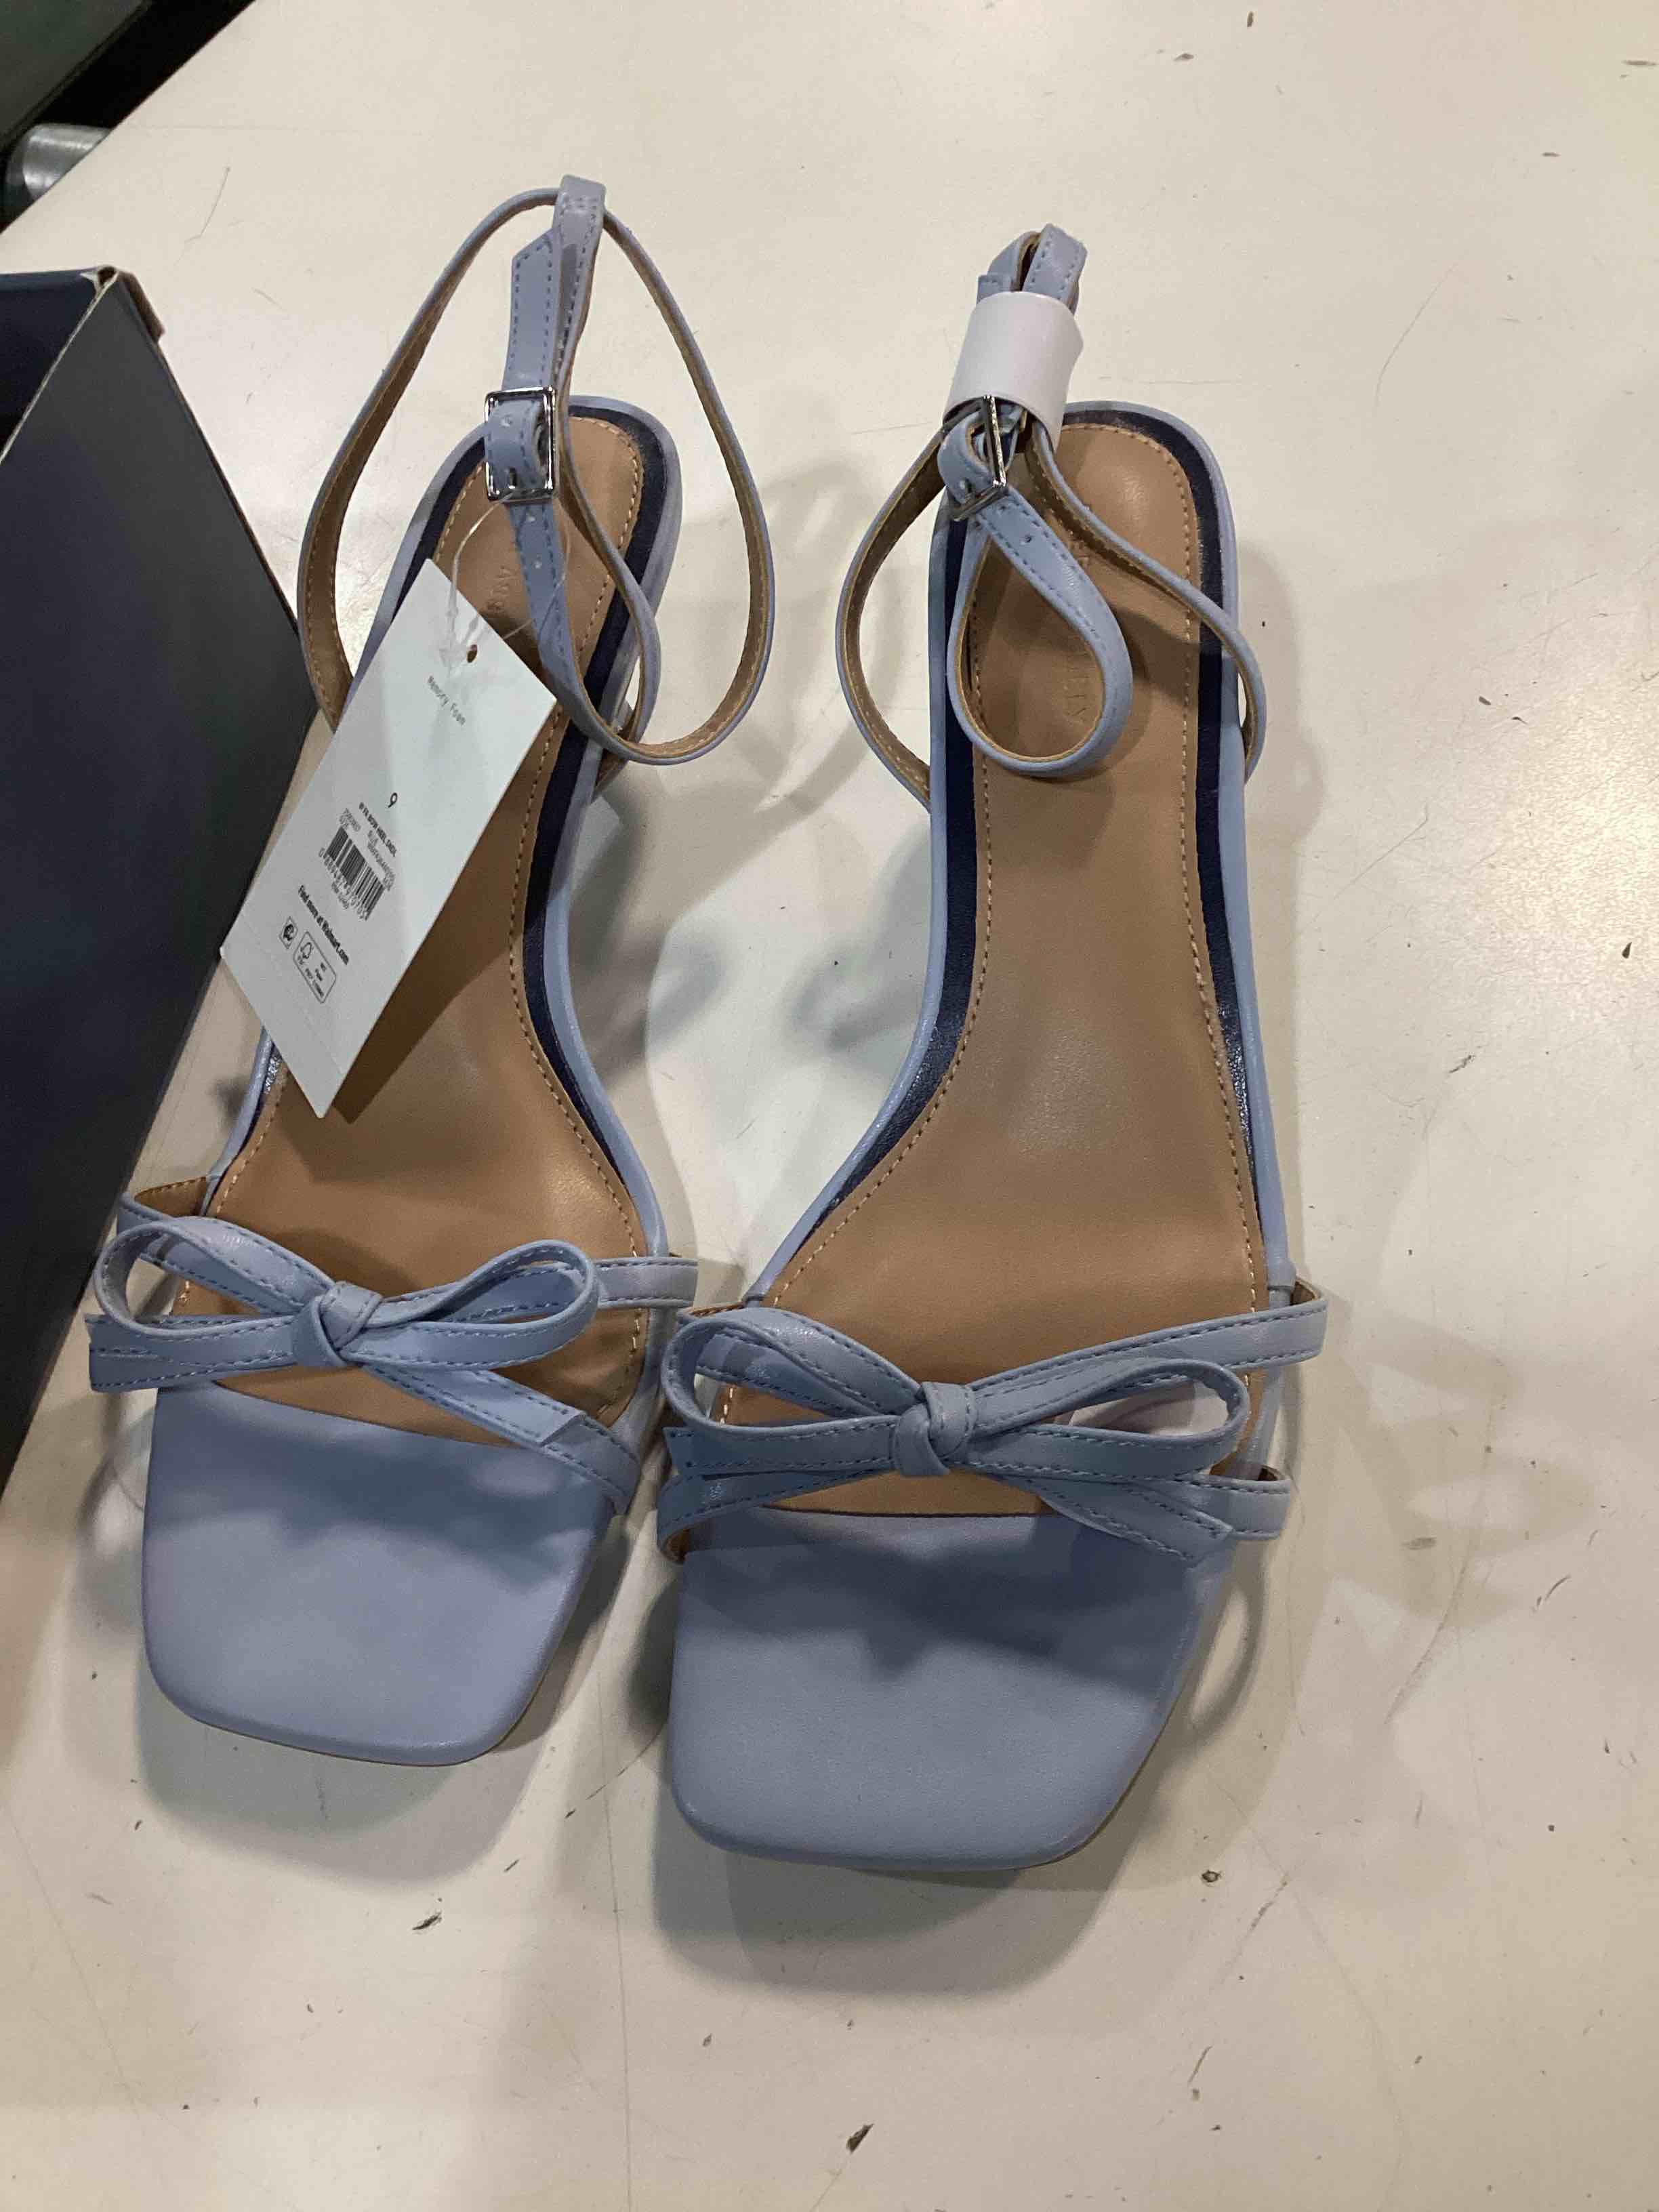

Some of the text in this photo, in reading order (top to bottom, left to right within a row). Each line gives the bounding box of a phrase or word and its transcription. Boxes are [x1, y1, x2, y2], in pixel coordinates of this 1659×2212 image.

[298, 885, 310, 905] Find
[306, 899, 319, 920] more
[316, 914, 325, 926] at
[321, 919, 349, 965] Walmart.com
